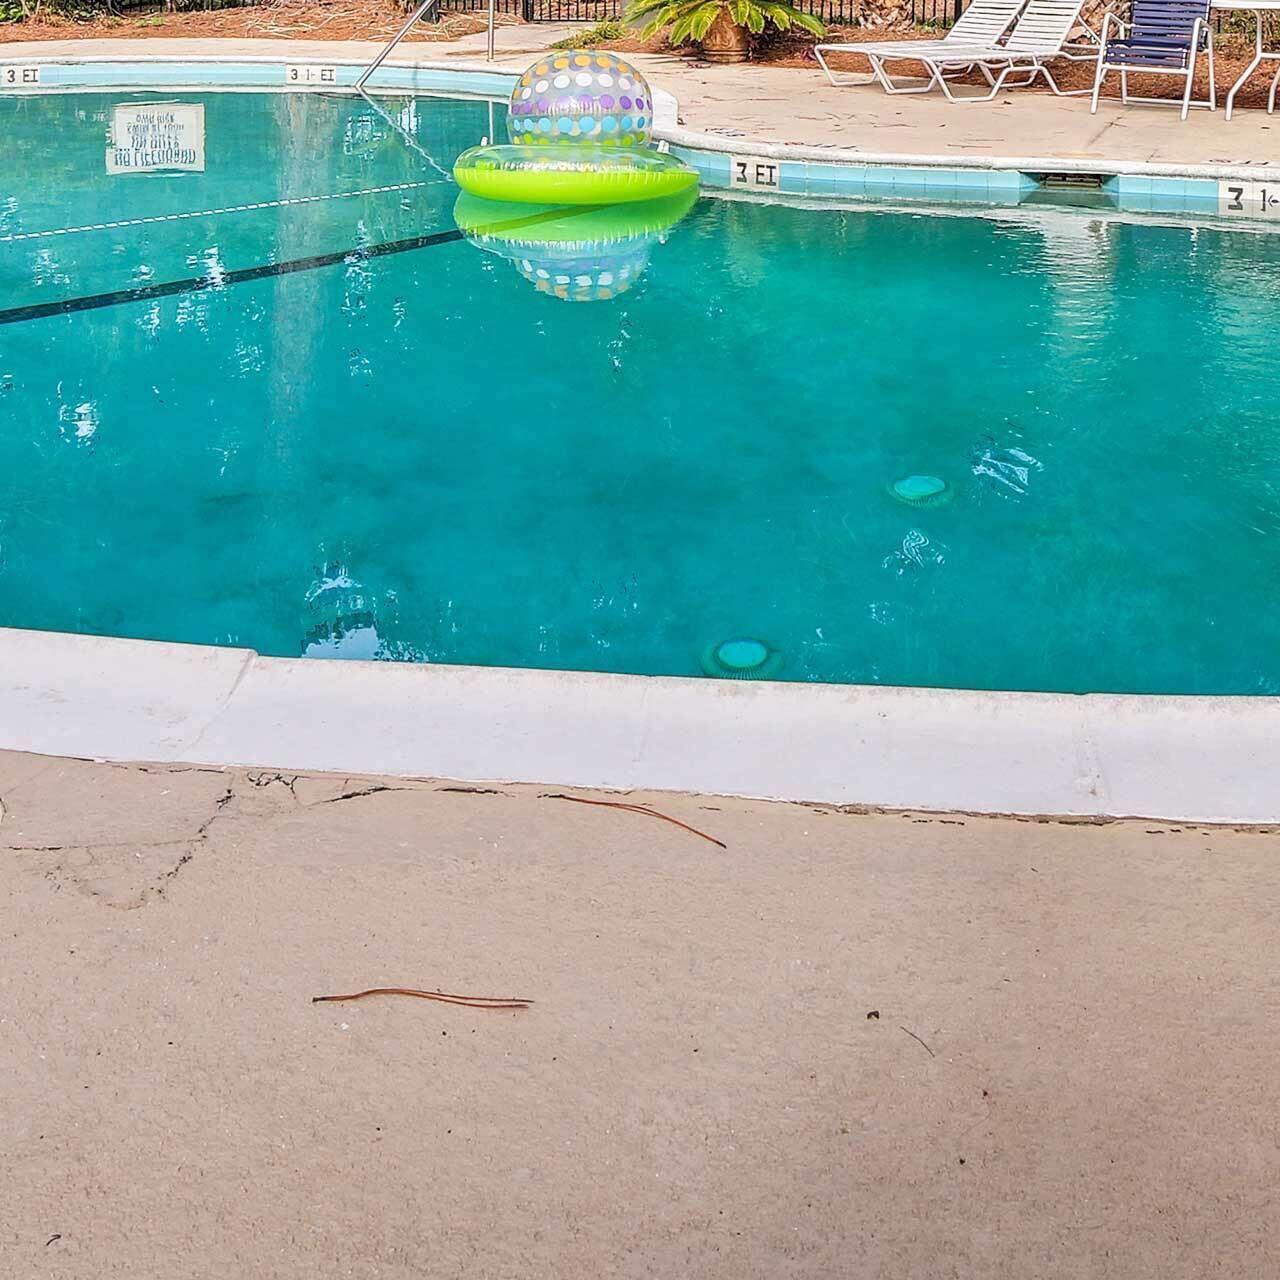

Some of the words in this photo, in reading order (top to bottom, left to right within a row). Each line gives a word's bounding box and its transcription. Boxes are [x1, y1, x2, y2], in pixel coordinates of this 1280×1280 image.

[7, 69, 16, 83] 3
[290, 68, 298, 81] 3
[736, 162, 748, 183] 3
[1227, 186, 1244, 211] 3
